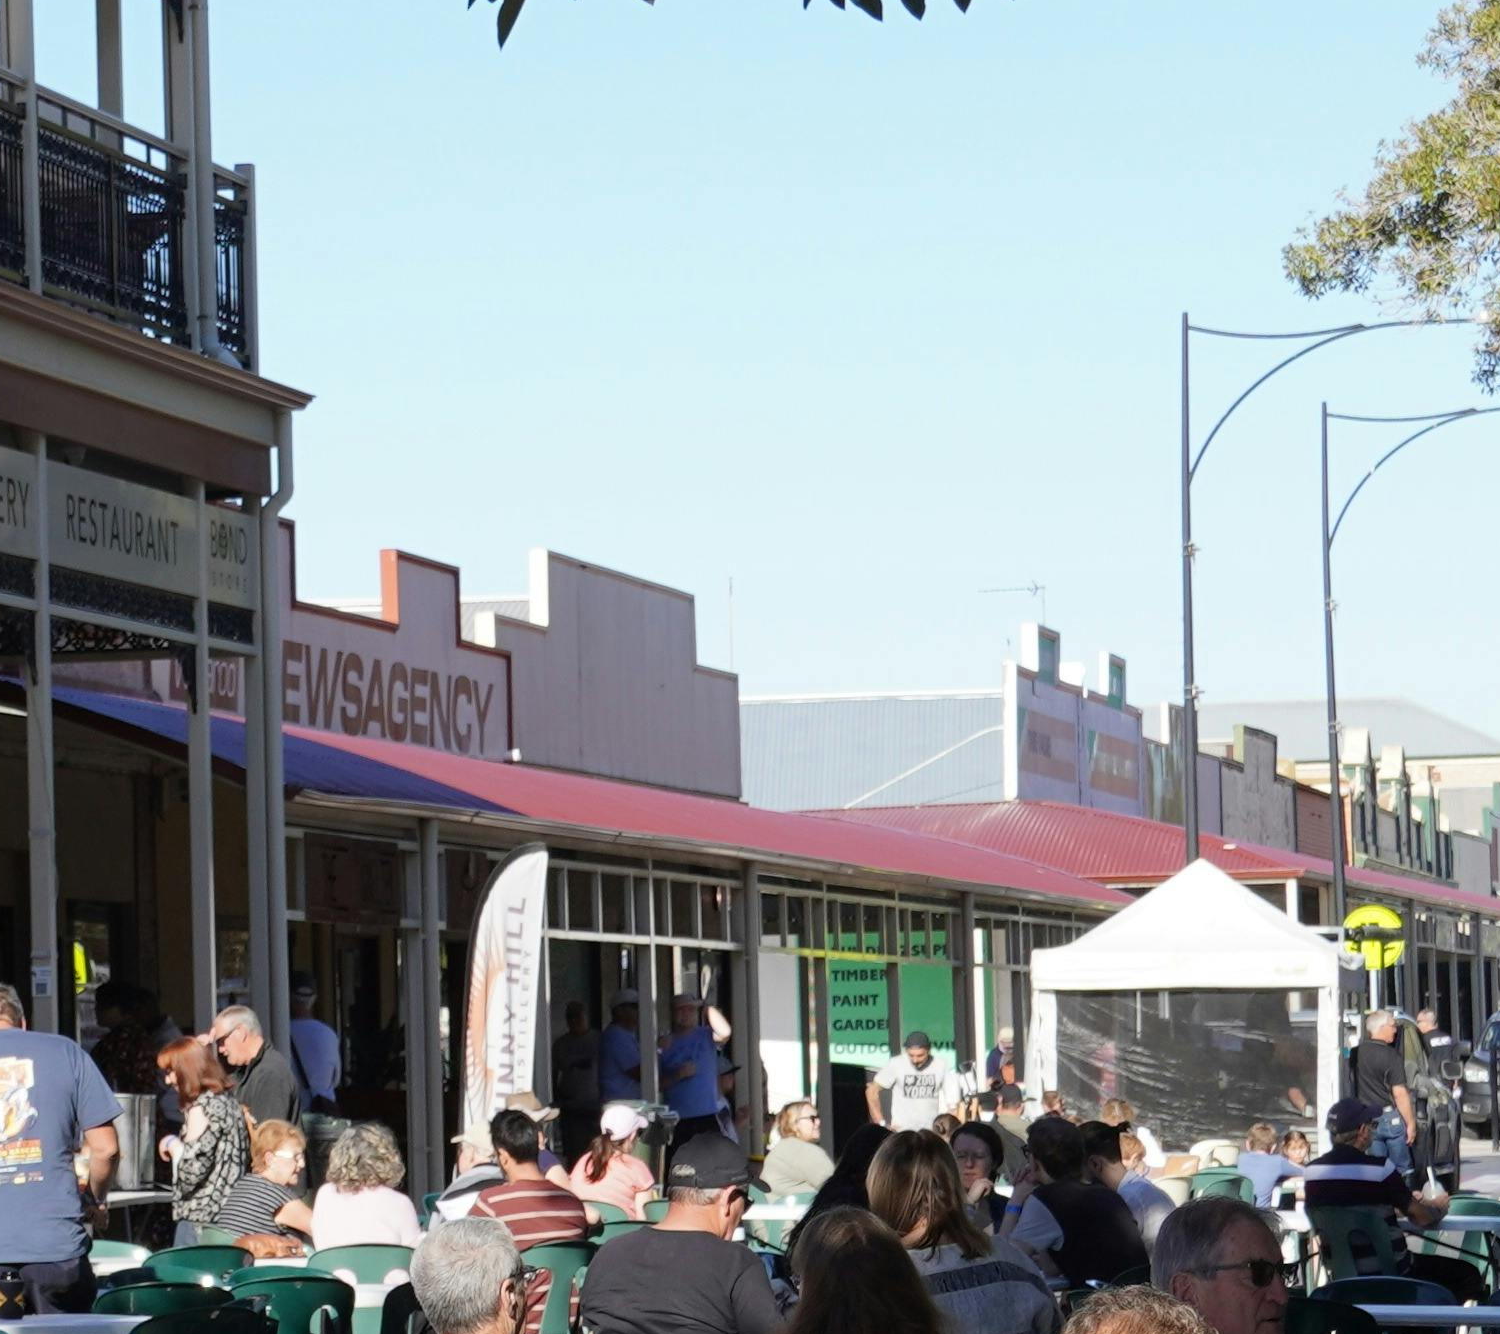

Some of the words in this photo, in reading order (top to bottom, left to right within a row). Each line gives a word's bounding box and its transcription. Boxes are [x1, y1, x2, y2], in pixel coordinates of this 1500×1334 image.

[66, 494, 179, 565] RESTAURANT
[210, 520, 248, 565] BOND
[283, 640, 494, 755] EWSAGENCY
[506, 897, 528, 986] HILL
[832, 994, 879, 1007] PAINT
[832, 1019, 890, 1032] GARDE
[833, 1043, 890, 1055] OUTDO
[916, 1075, 935, 1086] ZOO
[904, 1086, 934, 1099] YORK
